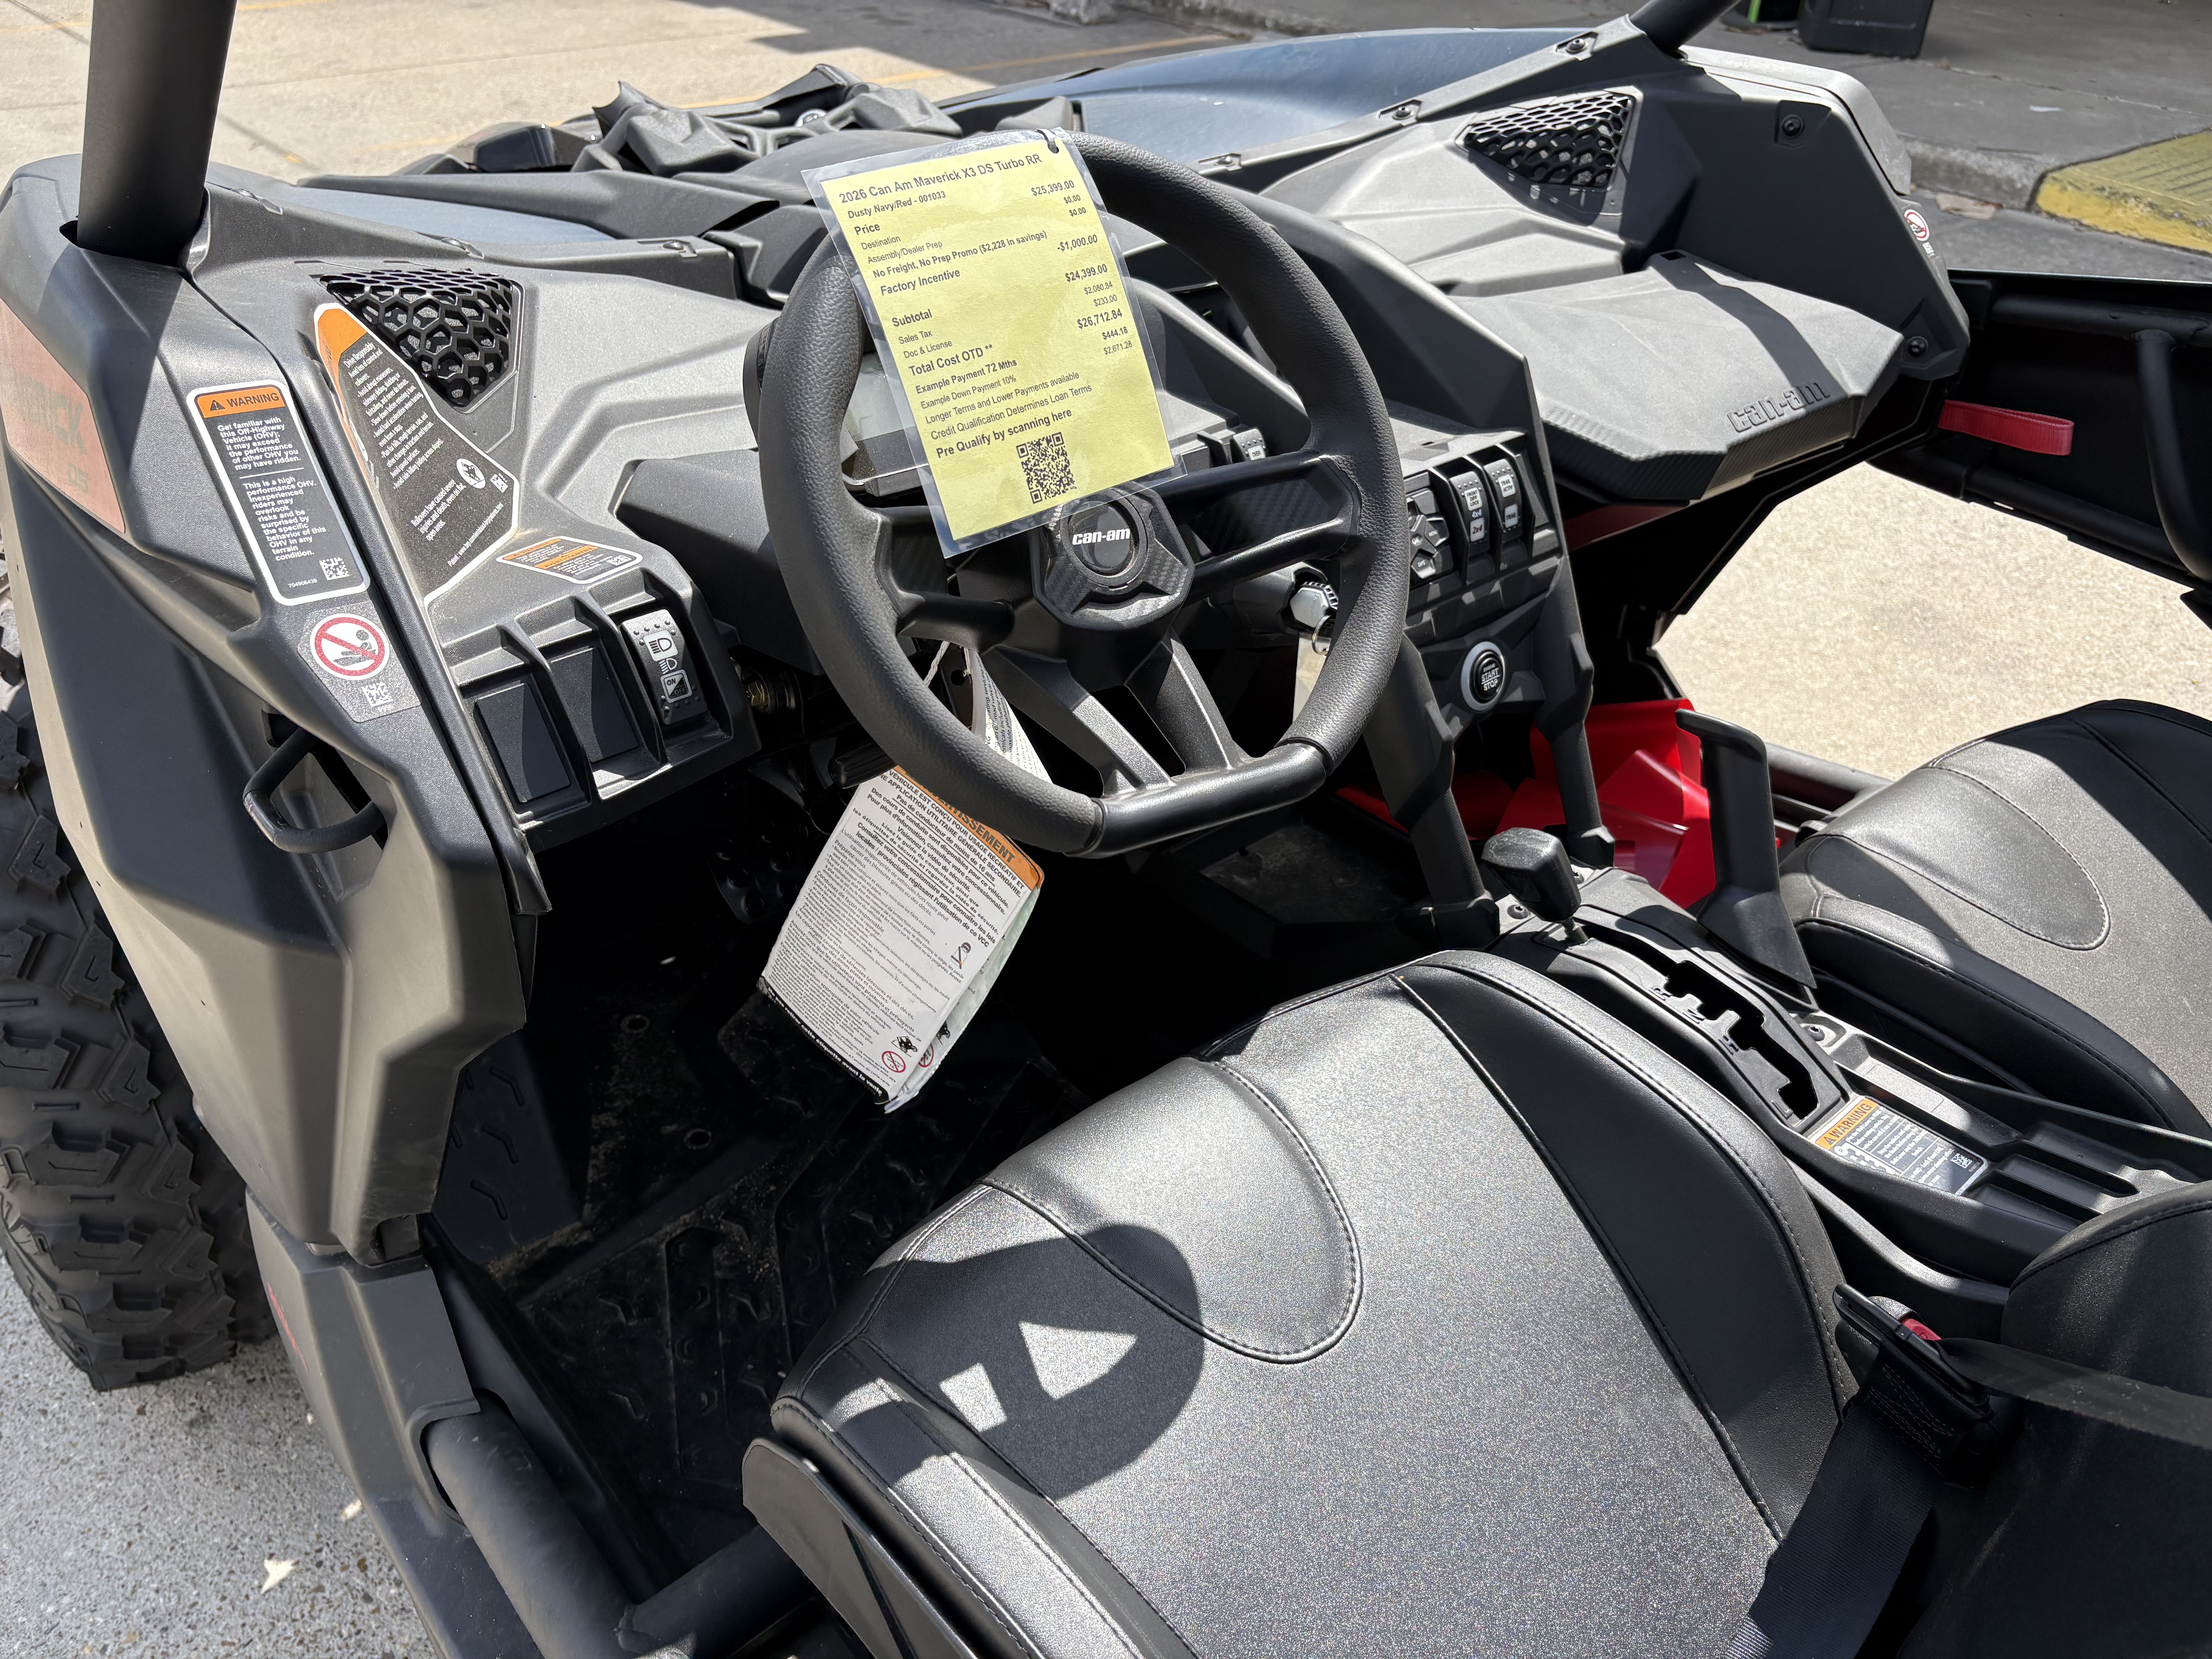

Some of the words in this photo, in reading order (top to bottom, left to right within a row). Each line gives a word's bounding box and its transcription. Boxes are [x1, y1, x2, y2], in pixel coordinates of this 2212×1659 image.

[838, 188, 867, 203] 2026
[868, 185, 892, 196] Can
[894, 181, 913, 192] Am
[913, 170, 962, 187] Maverick
[960, 167, 976, 179] X3
[977, 163, 994, 175] DS
[993, 158, 1025, 171] Turbo
[1025, 154, 1042, 165] RR
[1030, 180, 1075, 197] $25,399.00
[847, 208, 872, 219] Dusty
[873, 197, 912, 213] Navy/Red
[918, 190, 946, 203] 001033
[1063, 194, 1081, 204] $0.00
[1068, 206, 1086, 217] $0.00
[854, 223, 881, 235] Price
[860, 236, 901, 250] Destination
[1056, 234, 1098, 252] -$1,000.00
[867, 245, 925, 264] Assembly/Dealer
[925, 241, 943, 250] Prep
[872, 269, 886, 278] No
[886, 261, 919, 275] Freight,
[918, 258, 931, 267] No
[931, 254, 951, 264] Prep
[951, 247, 978, 259] Promo
[979, 239, 1006, 255] ($2,228
[1006, 238, 1015, 246] in
[1015, 230, 1047, 244] savings)
[1065, 263, 1108, 283] $24,399.00
[880, 280, 916, 296] Factory
[918, 270, 960, 286] Incentive
[1084, 280, 1113, 295] $2,080.84
[1092, 294, 1117, 307] $233.00
[891, 308, 933, 327] Subtotal
[1077, 307, 1122, 330] $26,712.84
[898, 334, 919, 344] Sales
[918, 330, 933, 338] Tax
[1101, 326, 1128, 340] $444.18
[343, 356, 356, 368] Drive
[352, 342, 376, 361] Responsibly
[903, 349, 919, 359] Doc
[919, 346, 926, 354] &
[925, 340, 953, 352] License
[908, 359, 935, 376] Total
[936, 353, 961, 368] Cost
[961, 347, 983, 361] OTD
[915, 378, 950, 394] Example
[950, 367, 986, 384] Payment
[984, 362, 998, 374] 72
[997, 359, 1017, 370] Mths
[920, 395, 950, 409] Example
[951, 389, 971, 400] Down
[971, 379, 1001, 394] Payment
[1001, 374, 1017, 385] 10%
[924, 410, 951, 424] Longer
[952, 404, 976, 415] Terms
[977, 397, 991, 409] and
[991, 392, 1013, 404] Lower
[1014, 381, 1049, 397] Payments
[1049, 371, 1079, 386] available
[226, 392, 279, 407] WARNING
[1726, 381, 1831, 433] can-am
[930, 425, 957, 440] Credit
[957, 411, 1005, 432] Qualification
[1005, 398, 1049, 417] Determines
[1049, 392, 1069, 403] Loan
[1068, 385, 1092, 397] Terms
[217, 424, 233, 433] Get
[232, 420, 263, 429] familiar
[263, 416, 282, 424] with
[237, 424, 285, 435] Off-Highway
[222, 435, 252, 445] Vehicle
[936, 447, 955, 459] Pre
[956, 433, 991, 452] Qualify
[992, 430, 1005, 441] by
[1007, 416, 1051, 436] scanning
[1050, 409, 1072, 422] here
[243, 443, 293, 456] performance
[252, 436, 280, 448] exceed
[242, 454, 263, 462] other
[264, 450, 283, 459] OHV
[283, 449, 299, 457] you
[273, 455, 301, 464] ridden.
[242, 481, 261, 489] This
[277, 476, 296, 484] high
[246, 483, 296, 498] performance
[296, 479, 316, 488] OHV.
[248, 488, 304, 503] Inexperienced
[410, 508, 429, 527] Rollovers
[424, 500, 436, 512] have
[433, 487, 447, 503] caused
[444, 479, 456, 492] severe
[252, 501, 276, 509] riders
[254, 504, 290, 515] overlook
[258, 514, 278, 522] risks
[279, 510, 294, 519] and
[260, 516, 300, 529] surprised
[275, 521, 309, 533] specific
[1472, 525, 1482, 534] 2x4
[266, 531, 301, 542] behavior
[269, 539, 287, 550] OHV
[288, 538, 297, 546] in
[1072, 528, 1130, 545] can-am
[271, 545, 299, 555] terrain
[275, 550, 315, 561] condition.
[1481, 667, 1499, 682] START
[1484, 679, 1498, 690] STOP
[890, 770, 919, 795] VÉHICULE
[919, 793, 931, 804] EST
[931, 803, 952, 823] CONÇU
[952, 820, 969, 837] POUR
[969, 835, 988, 854] USAGE
[988, 852, 1017, 881] RÉCRÉATIF
[1017, 879, 1024, 889] ET
[888, 780, 927, 811] APPLICATION
[927, 809, 958, 838] UTILITAIRE
[958, 835, 988, 864] GÉNÉRALE
[987, 862, 1021, 898] SECONDAIRE.
[896, 795, 907, 805] Pas
[915, 811, 946, 838] conducteur
[953, 843, 970, 859] moins
[971, 857, 977, 866] de
[979, 864, 985, 872] 16
[985, 871, 995, 882] ans
[1829, 1103, 1872, 1138] WARNING
